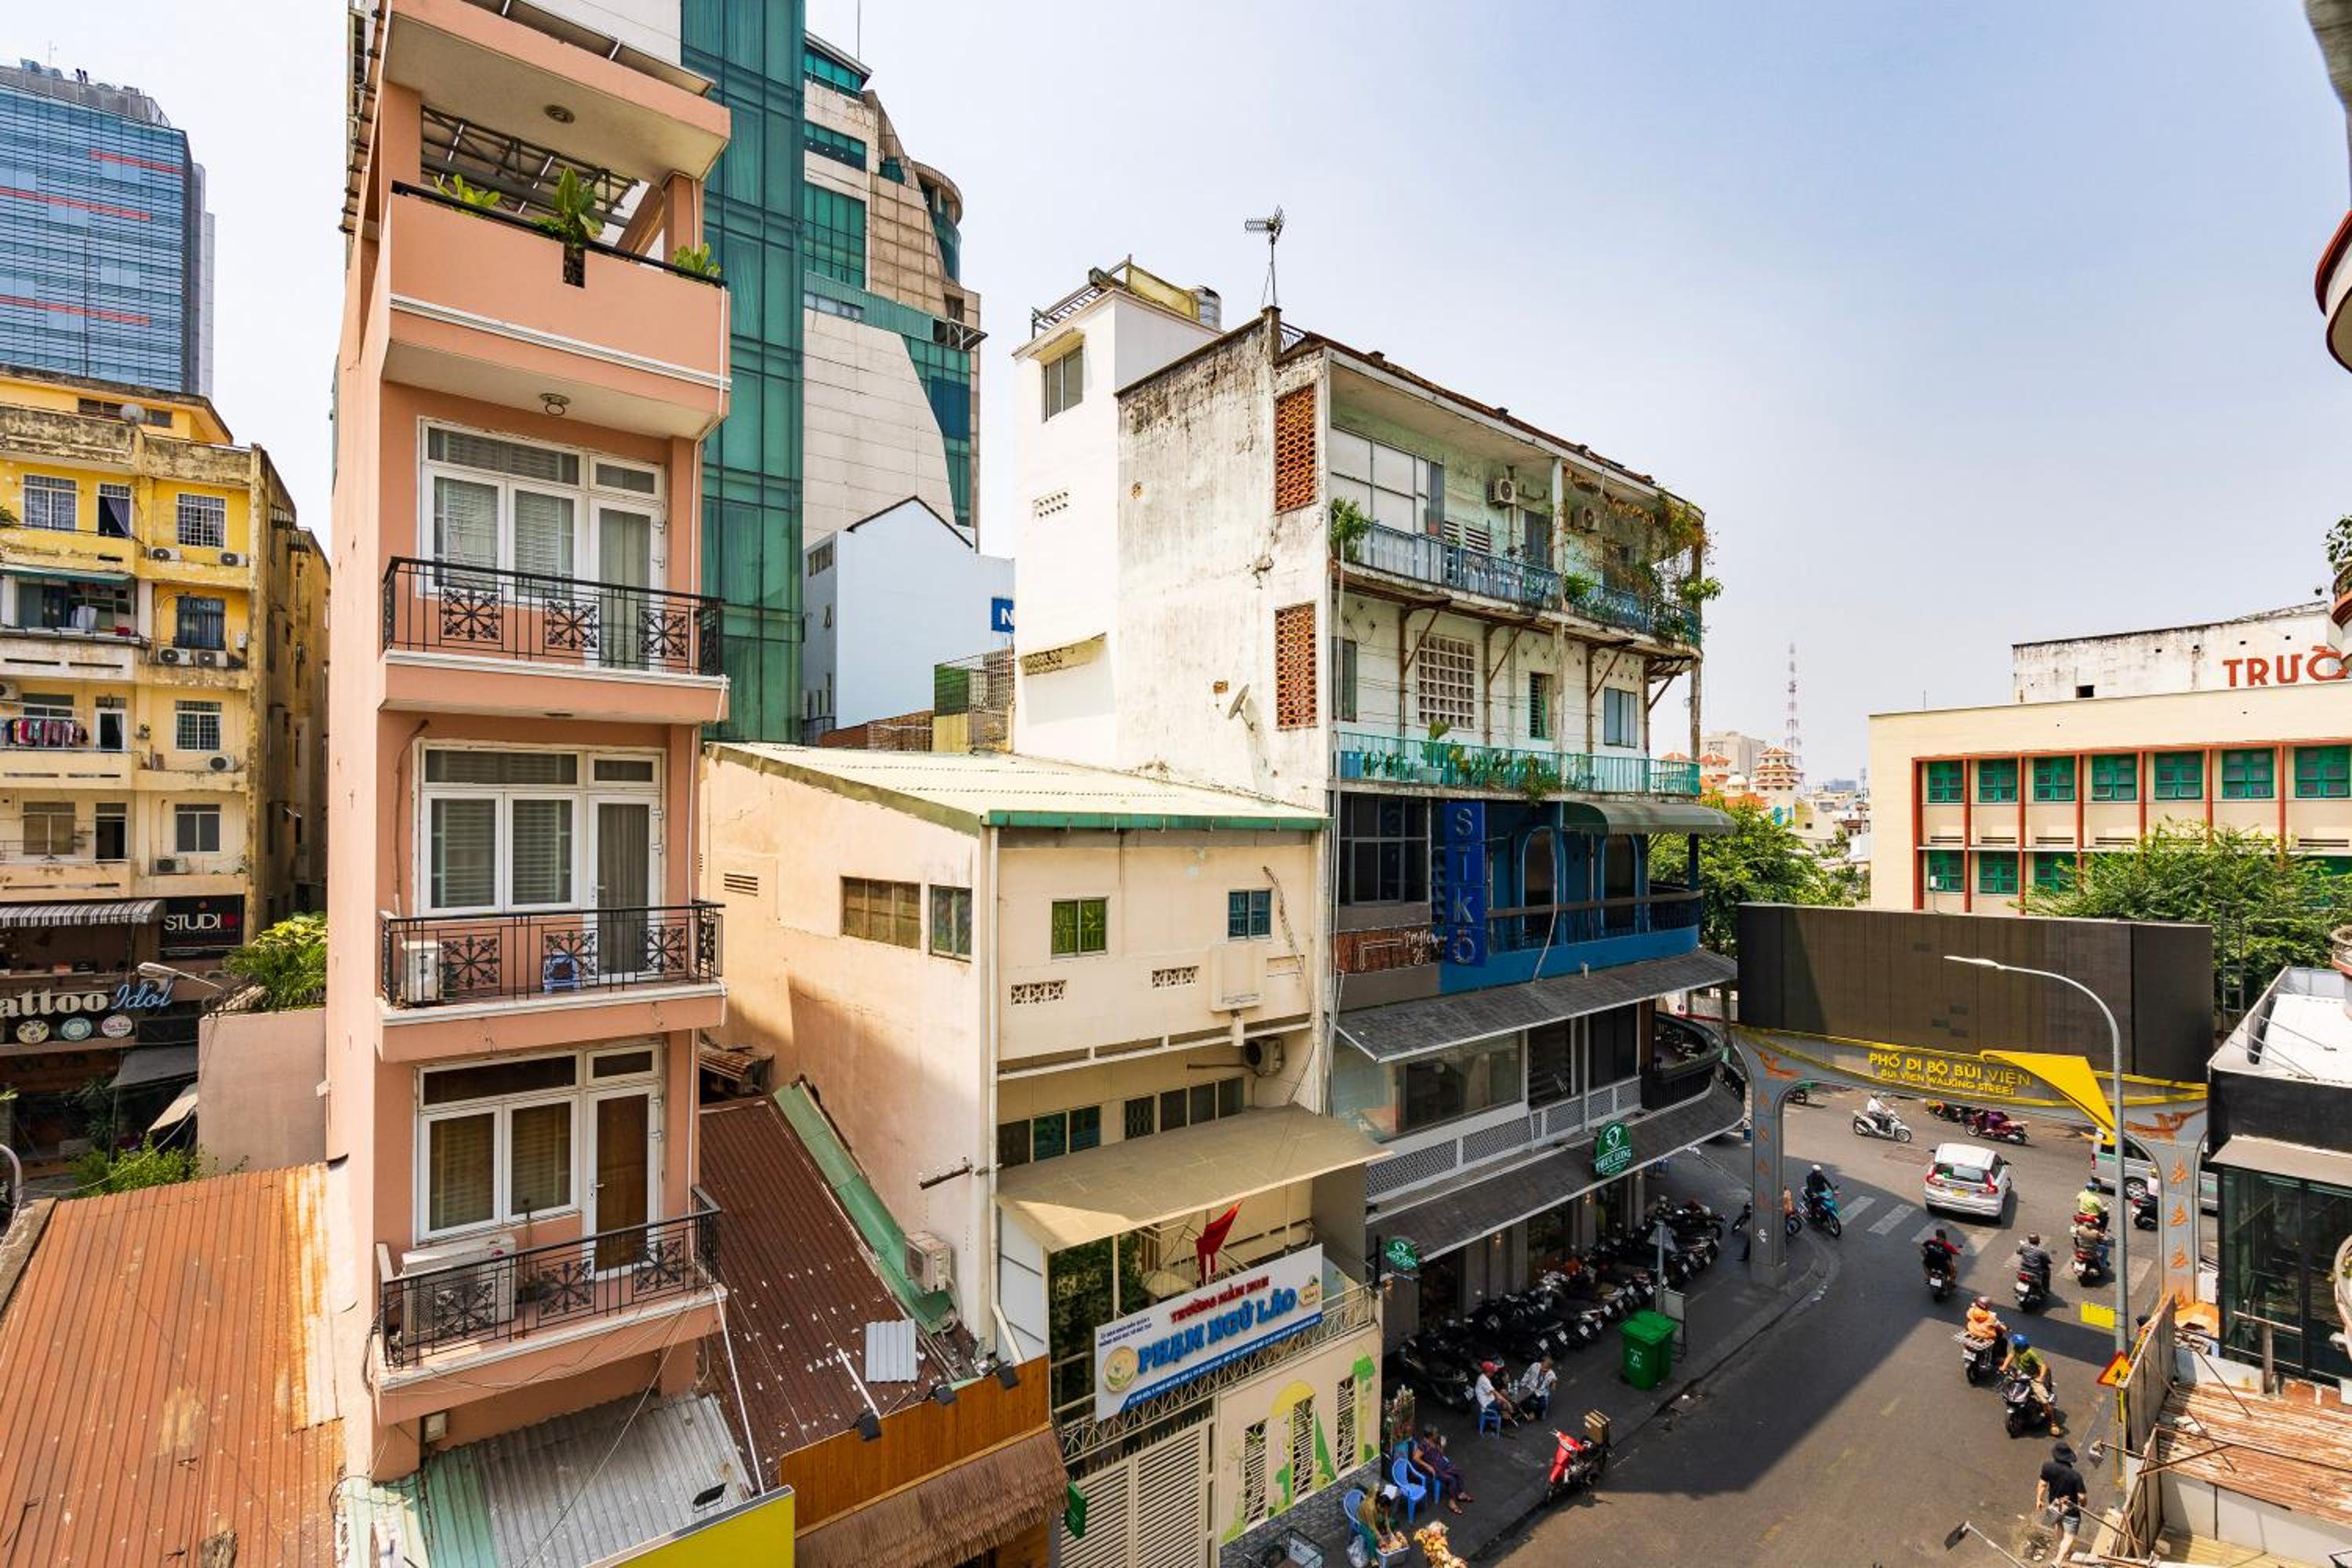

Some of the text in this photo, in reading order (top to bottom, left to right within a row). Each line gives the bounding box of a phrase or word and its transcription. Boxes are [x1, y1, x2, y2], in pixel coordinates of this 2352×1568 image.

[111, 983, 173, 1009] Idol
[1869, 1052, 1901, 1068] PHỐ
[1906, 1058, 1922, 1071] ĐI
[1927, 1060, 1949, 1076] BỘ
[1955, 1063, 1982, 1080] BÙI
[1928, 1076, 1975, 1089] WALKING
[1978, 1083, 2015, 1095] STREET
